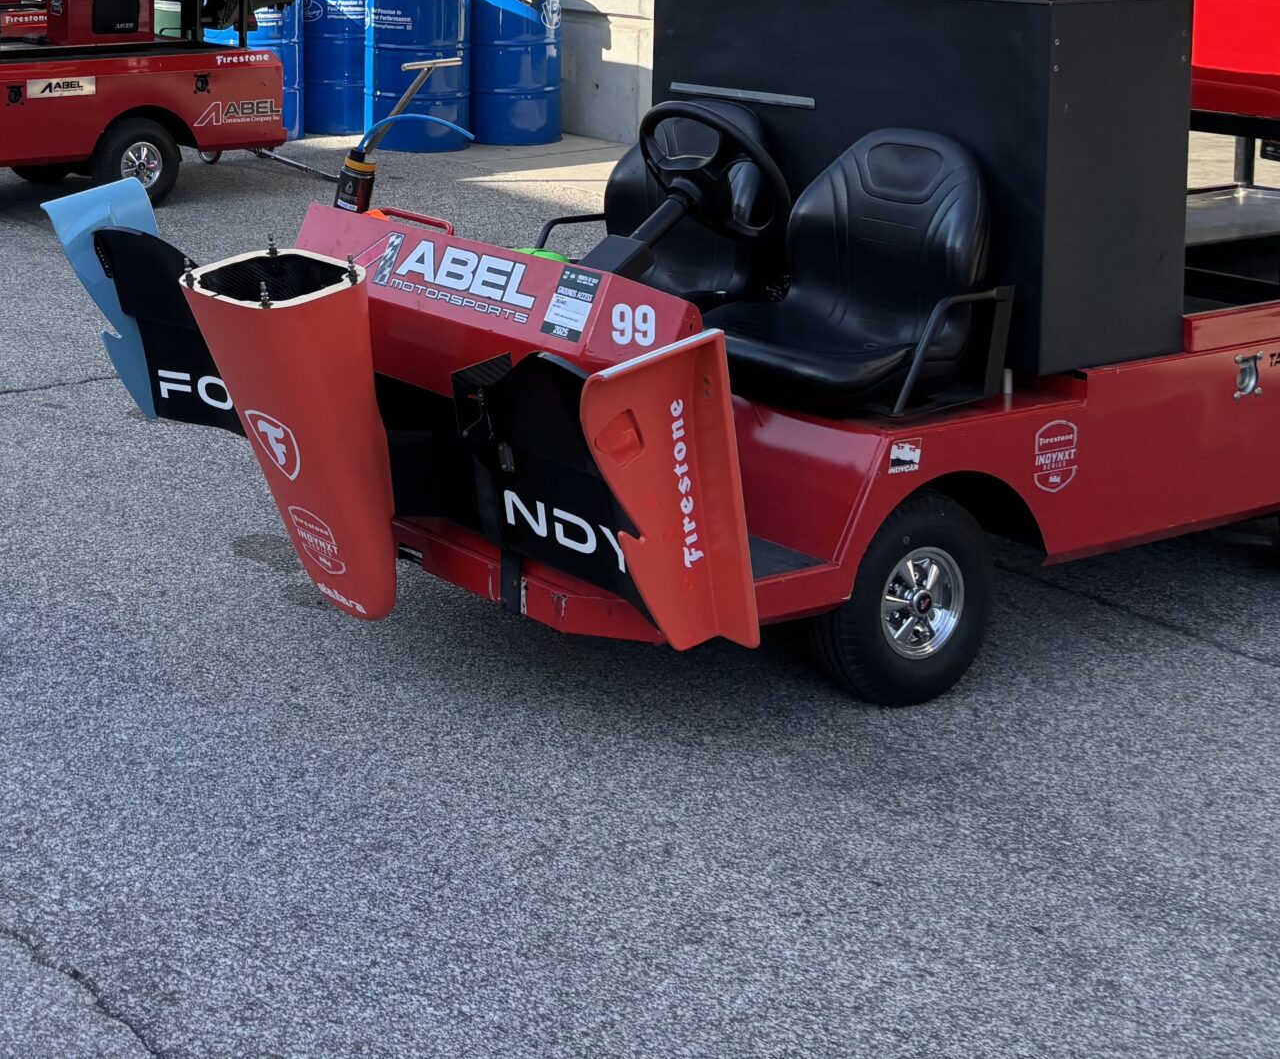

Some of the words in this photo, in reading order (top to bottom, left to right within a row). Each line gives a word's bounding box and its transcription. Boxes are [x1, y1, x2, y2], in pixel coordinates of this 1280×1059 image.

[216, 53, 269, 65] Firestone
[53, 81, 84, 90] ABEL
[223, 99, 282, 117] ABEL
[223, 115, 250, 124] Construction
[251, 115, 272, 123] Company
[395, 239, 537, 310] ABEL
[389, 278, 530, 325] MOTORSPORTS
[557, 286, 578, 298] GROUNDS
[577, 291, 594, 302] ACCESS
[552, 325, 570, 336] 2025
[611, 303, 656, 347] 99
[257, 419, 287, 466] F
[1039, 434, 1074, 446] Firestone
[1035, 449, 1076, 466] INDYNXT
[888, 464, 919, 474] INDYCAR
[1042, 461, 1067, 471] SERIES
[670, 398, 704, 569] Firestone
[503, 489, 627, 574] NDY
